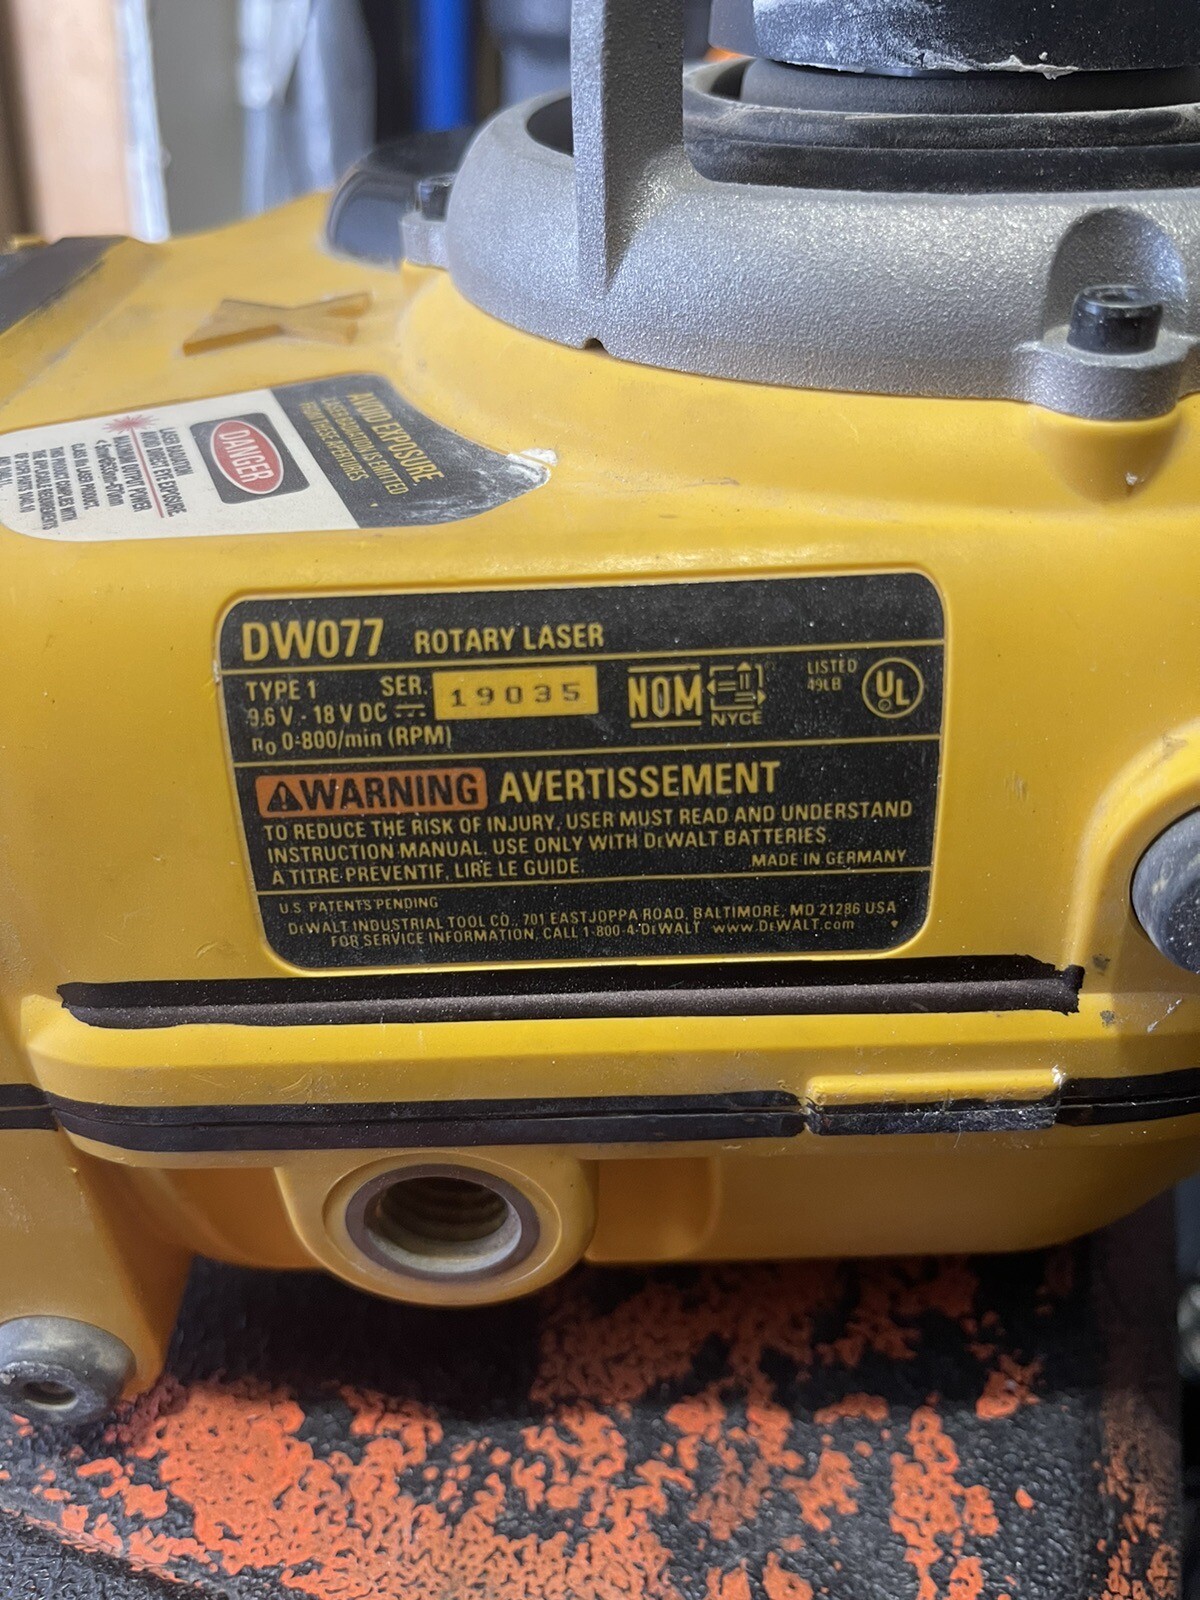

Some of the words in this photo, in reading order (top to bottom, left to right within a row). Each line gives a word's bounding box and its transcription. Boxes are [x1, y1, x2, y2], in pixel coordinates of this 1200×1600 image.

[310, 419, 341, 442] THESE
[345, 392, 393, 422] AVOID
[371, 421, 445, 483] EXPOSURE
[217, 429, 276, 485] DANGER
[325, 440, 370, 482] APERTURES
[368, 460, 409, 495] EMITTED
[128, 488, 153, 513] POWER
[242, 618, 384, 662] DW077
[414, 627, 515, 655] ROTARY
[523, 621, 604, 650] LASER
[807, 659, 858, 675] LISTED
[246, 680, 301, 701] TYPE
[307, 679, 317, 699] 1
[380, 675, 428, 697] SER.
[449, 681, 581, 707] 19035
[628, 674, 703, 719] NOM
[875, 670, 911, 706] UL
[249, 707, 276, 727] 9.6
[280, 706, 293, 726] V
[313, 704, 335, 724] 18
[340, 703, 352, 723] V
[359, 702, 388, 723] DC
[711, 711, 763, 726] NYCE
[281, 729, 382, 750] 0-800/min
[388, 725, 452, 748] (RPM)
[299, 772, 479, 811] WARNING
[500, 761, 780, 804] AVERTISSEMENT
[264, 824, 287, 841] TO
[294, 821, 366, 840] REDUCE
[370, 819, 406, 838] THE
[414, 817, 453, 836] RISK
[461, 816, 482, 834] OF
[566, 811, 614, 830] USER
[620, 809, 673, 827] MUST
[679, 806, 728, 824] READ
[734, 804, 775, 822] AND
[782, 801, 913, 821] UNDERSTAND
[268, 845, 394, 864] INSTRUCTION
[401, 840, 487, 859] MANUAL.
[493, 838, 528, 855] USE
[534, 836, 583, 853] ONLY
[589, 833, 638, 850] WITH
[751, 852, 798, 867] MADE
[803, 851, 821, 866] IN
[826, 849, 907, 865] GERMANY
[273, 870, 284, 885] A
[289, 867, 340, 885] TITRE
[455, 861, 492, 879] LIRE
[499, 860, 518, 876] LE
[524, 858, 584, 876] GUIDE.
[309, 900, 372, 913] PATENTS
[376, 896, 439, 911] PENDING
[353, 917, 444, 932] INDUSTRIAL
[448, 915, 486, 929] TOOL
[523, 913, 545, 926] 701
[790, 904, 815, 917] MD
[819, 902, 860, 917] 21286
[865, 900, 896, 915] USA
[331, 934, 359, 948] FOR
[363, 931, 425, 947] SERVICE
[543, 926, 578, 940] CALL
